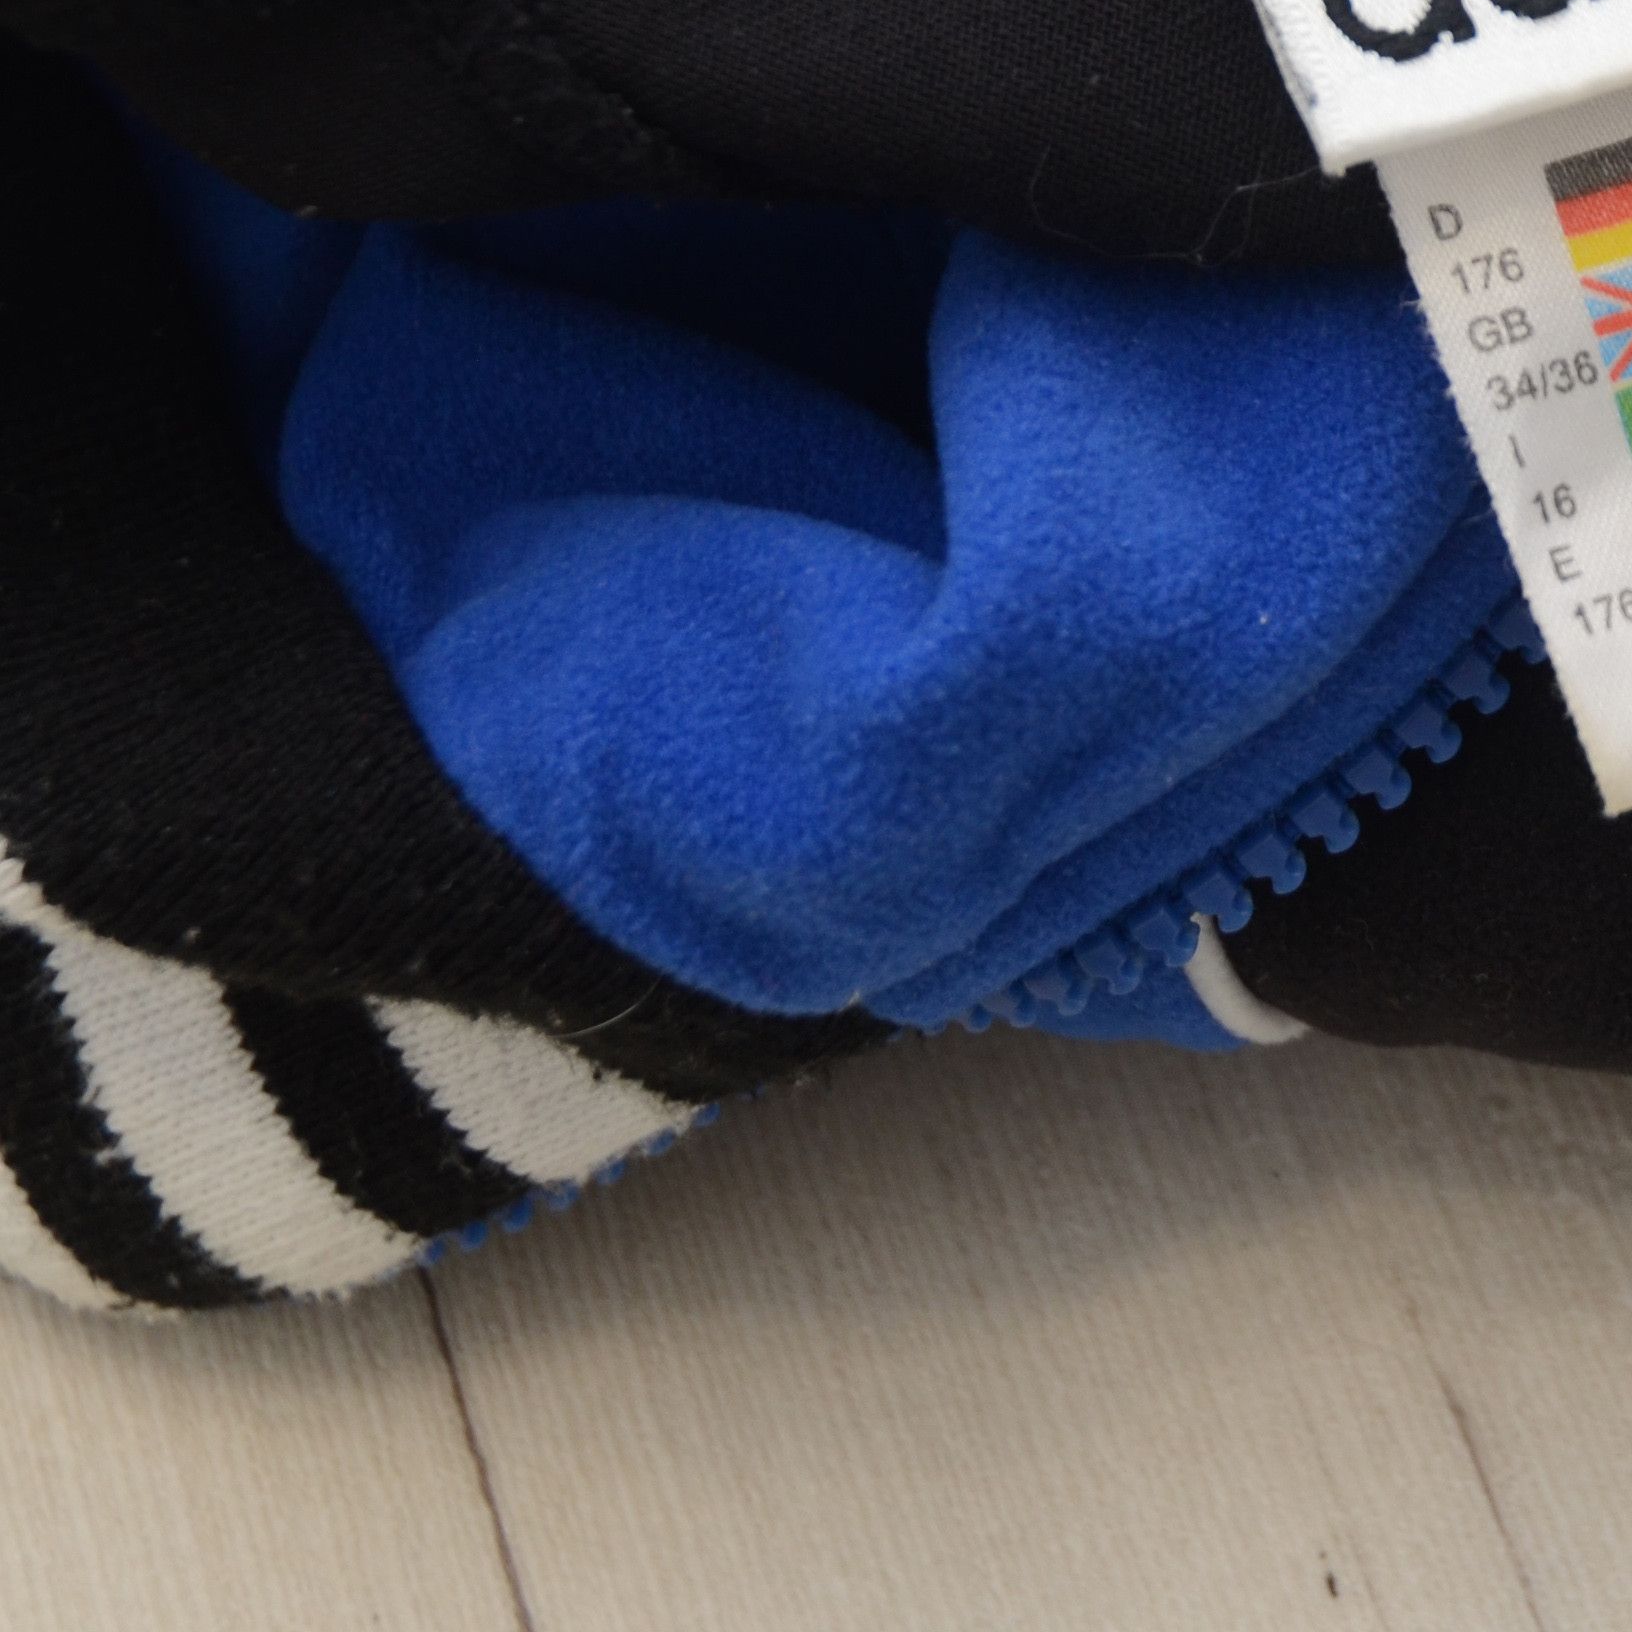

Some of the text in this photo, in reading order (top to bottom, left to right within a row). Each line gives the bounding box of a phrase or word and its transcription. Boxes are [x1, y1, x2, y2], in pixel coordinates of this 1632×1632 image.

[1428, 203, 1463, 240] D
[1452, 248, 1525, 294] 176
[1468, 307, 1534, 354] GB
[1486, 350, 1599, 410] 34/36
[1534, 483, 1577, 524] 16
[1549, 546, 1582, 582] E
